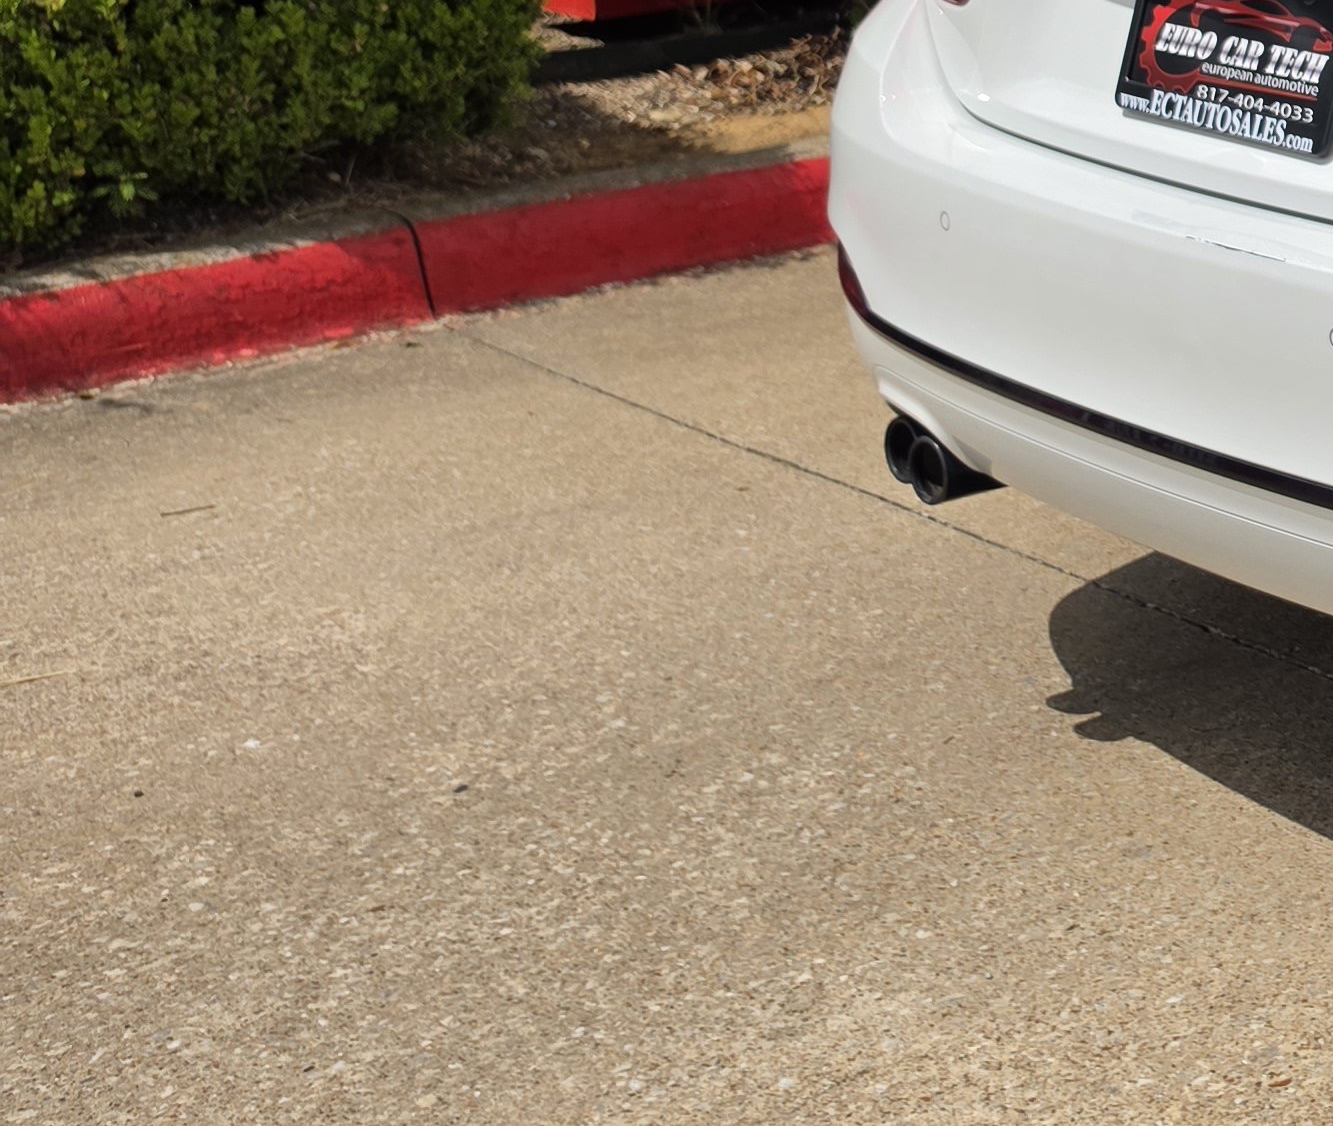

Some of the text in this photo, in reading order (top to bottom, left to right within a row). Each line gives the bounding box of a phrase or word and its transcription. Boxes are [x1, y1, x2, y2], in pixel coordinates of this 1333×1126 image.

[1154, 22, 1330, 84] EURO CAR TECH
[1196, 84, 1315, 124] 817-404-4033
[1201, 61, 1320, 98] european automotive
[1119, 88, 1314, 154] www.ECTAUTOSALES.com
